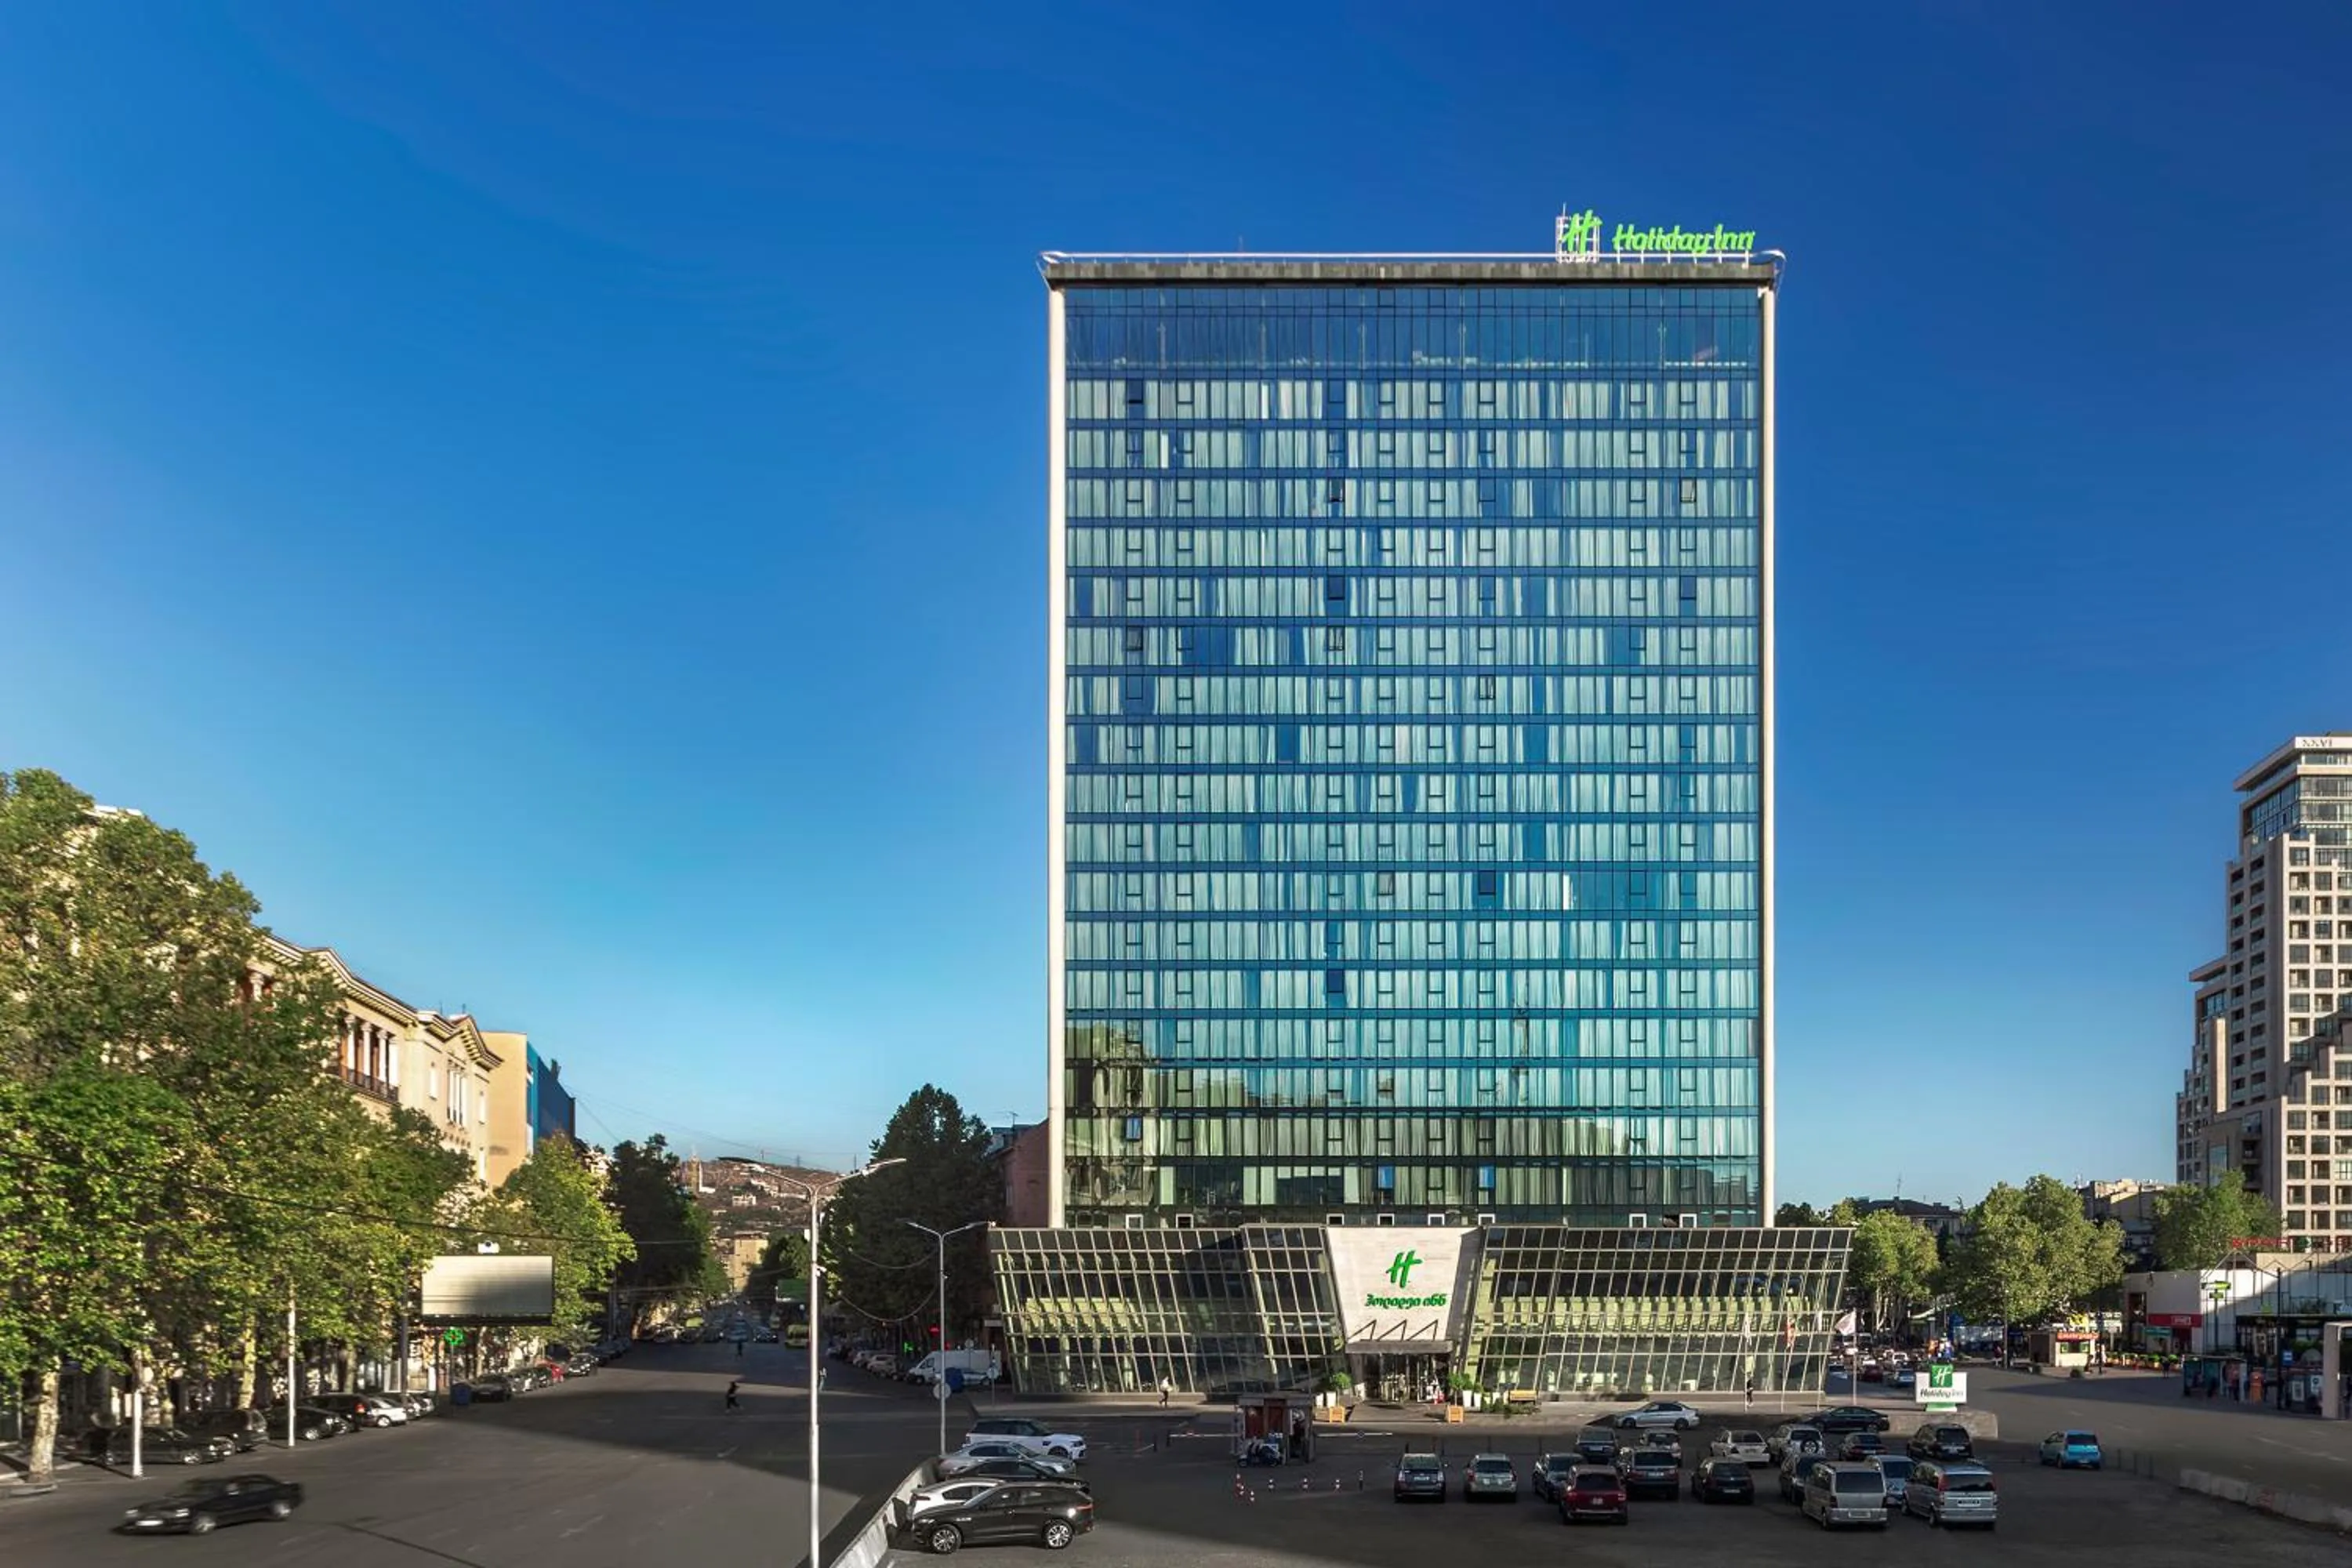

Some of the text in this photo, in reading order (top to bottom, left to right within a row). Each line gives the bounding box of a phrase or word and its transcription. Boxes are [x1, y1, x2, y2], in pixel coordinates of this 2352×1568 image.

[1612, 223, 1755, 254] Holiday Inn
[2303, 739, 2332, 747] XXVI
[1920, 1388, 1951, 1398] Holiday
